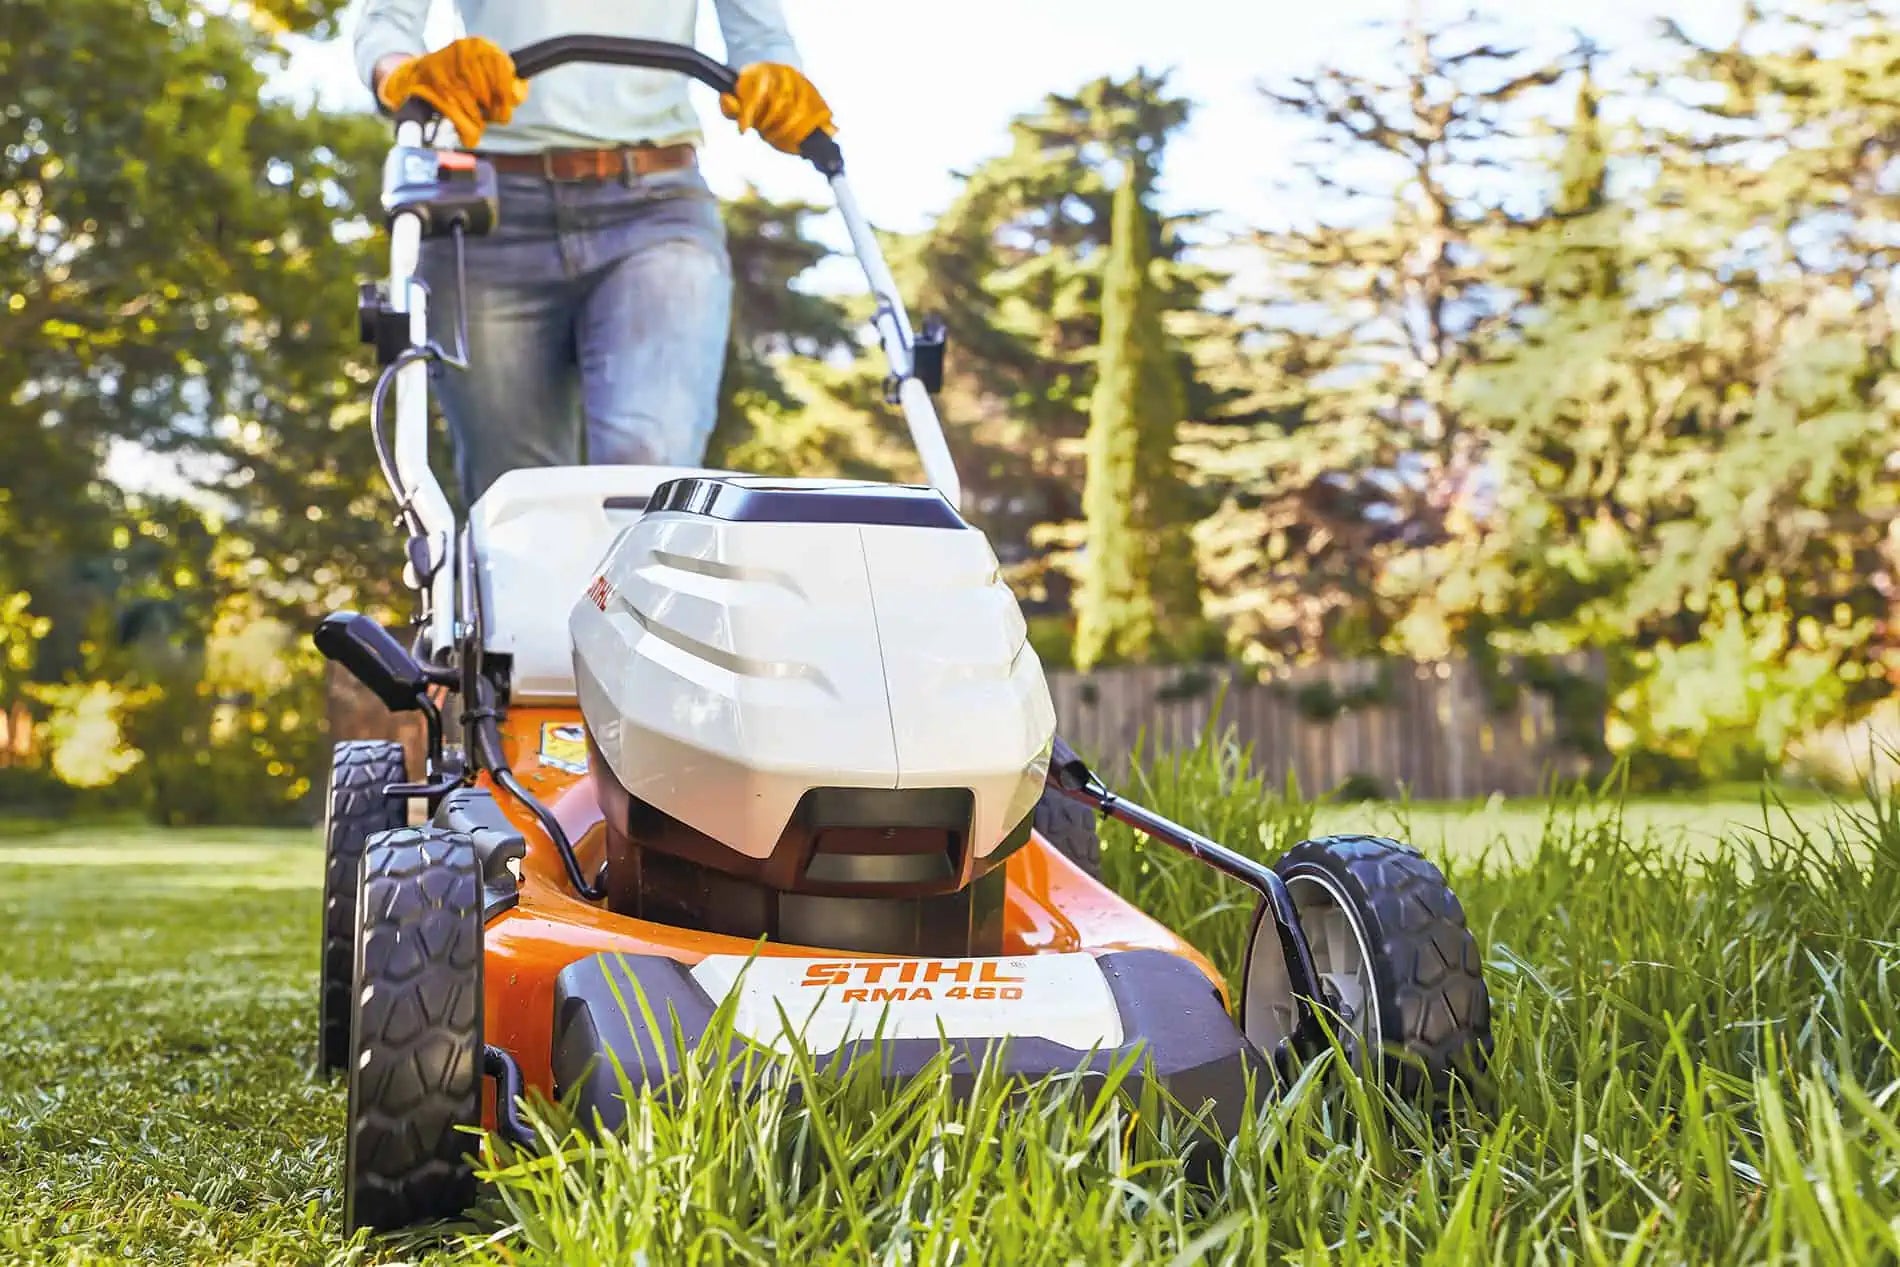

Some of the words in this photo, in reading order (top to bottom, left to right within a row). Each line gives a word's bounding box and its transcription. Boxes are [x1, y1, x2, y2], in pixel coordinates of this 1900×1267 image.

[801, 961, 1025, 986] STIHL
[842, 987, 932, 1002] RMA
[945, 986, 1023, 1000] 460
